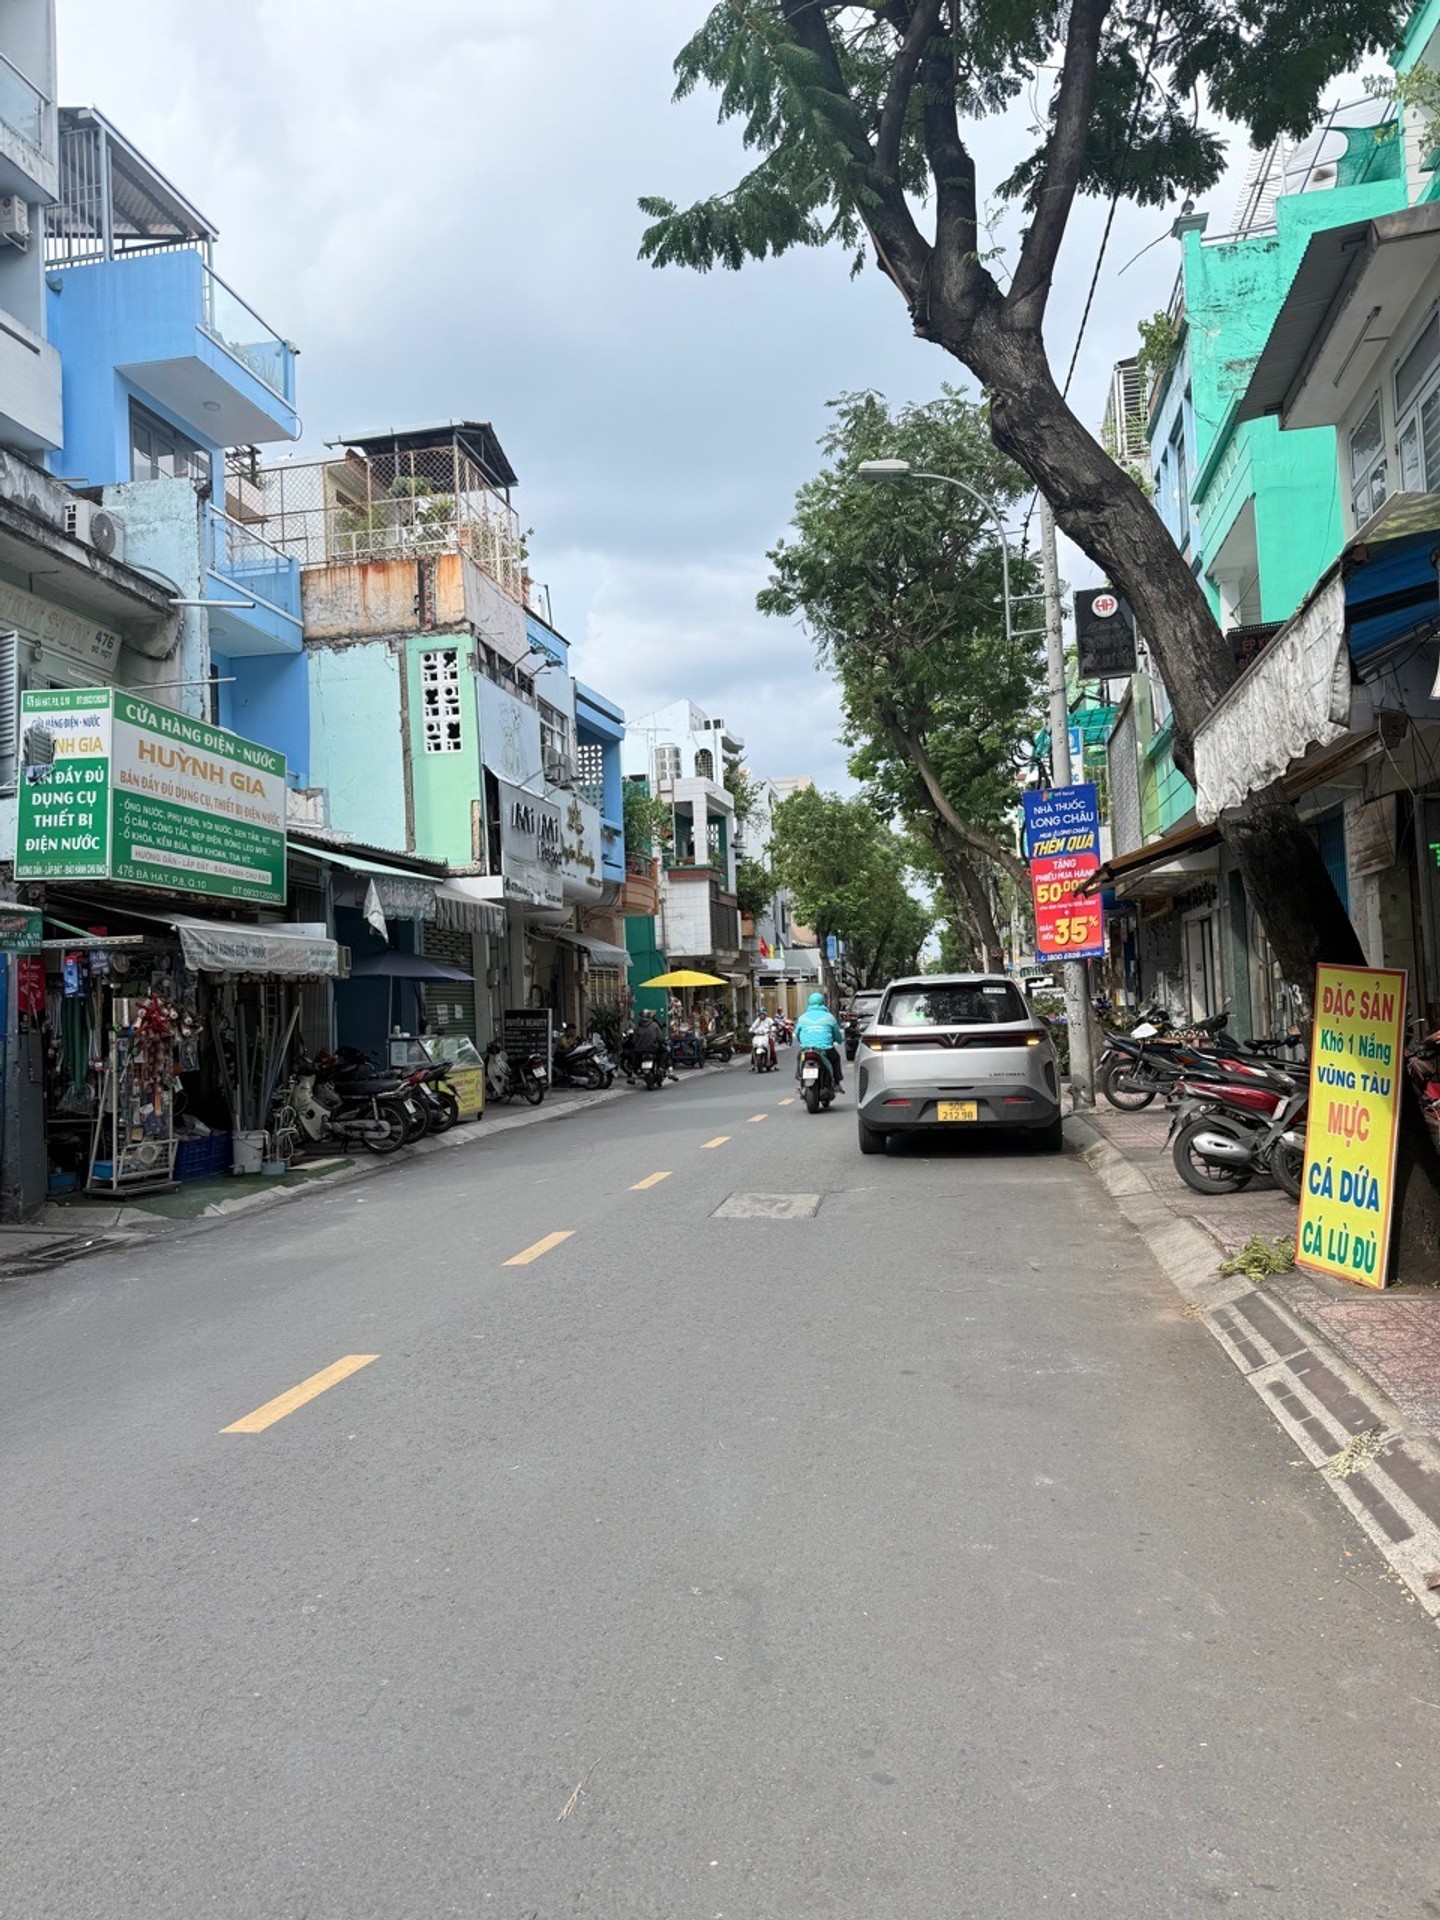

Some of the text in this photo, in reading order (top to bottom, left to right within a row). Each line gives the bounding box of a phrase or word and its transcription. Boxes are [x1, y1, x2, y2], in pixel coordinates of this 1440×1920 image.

[95, 630, 115, 649] 476
[79, 736, 103, 752] GIA
[126, 703, 158, 727] CỬA
[161, 717, 201, 743] HÀNG
[203, 733, 235, 758] ĐIỆN
[243, 749, 276, 770] NƯỚC
[84, 765, 104, 783] ĐỦ
[138, 739, 266, 798] HUỲNH GIA
[120, 769, 139, 785] BÁN
[176, 787, 199, 804] DỤNG
[32, 791, 96, 809] DỤNG CỤ
[1033, 798, 1086, 815] NHÀ THUỐC
[33, 808, 92, 829] THIẾT BỊ
[1030, 810, 1094, 829] LONG CHÂU
[25, 833, 100, 855] ĐIỆN NƯỚC
[1033, 831, 1095, 857] THÊM QUÀ
[117, 864, 135, 878] 476
[137, 869, 149, 880] BÀ
[1053, 858, 1077, 871] TẶNG
[1035, 872, 1057, 883] PHIẾU
[1058, 871, 1073, 880] MUA
[1322, 981, 1394, 1024] ĐẶC SẢN
[1321, 1029, 1392, 1066] Khô 1 Nắng
[1317, 1063, 1391, 1096] VŨNG TÀU
[1328, 1100, 1370, 1148] MỰC
[1308, 1156, 1380, 1212] CÁ DỨA
[1302, 1215, 1377, 1274] CÁ LÙ ĐÙ
